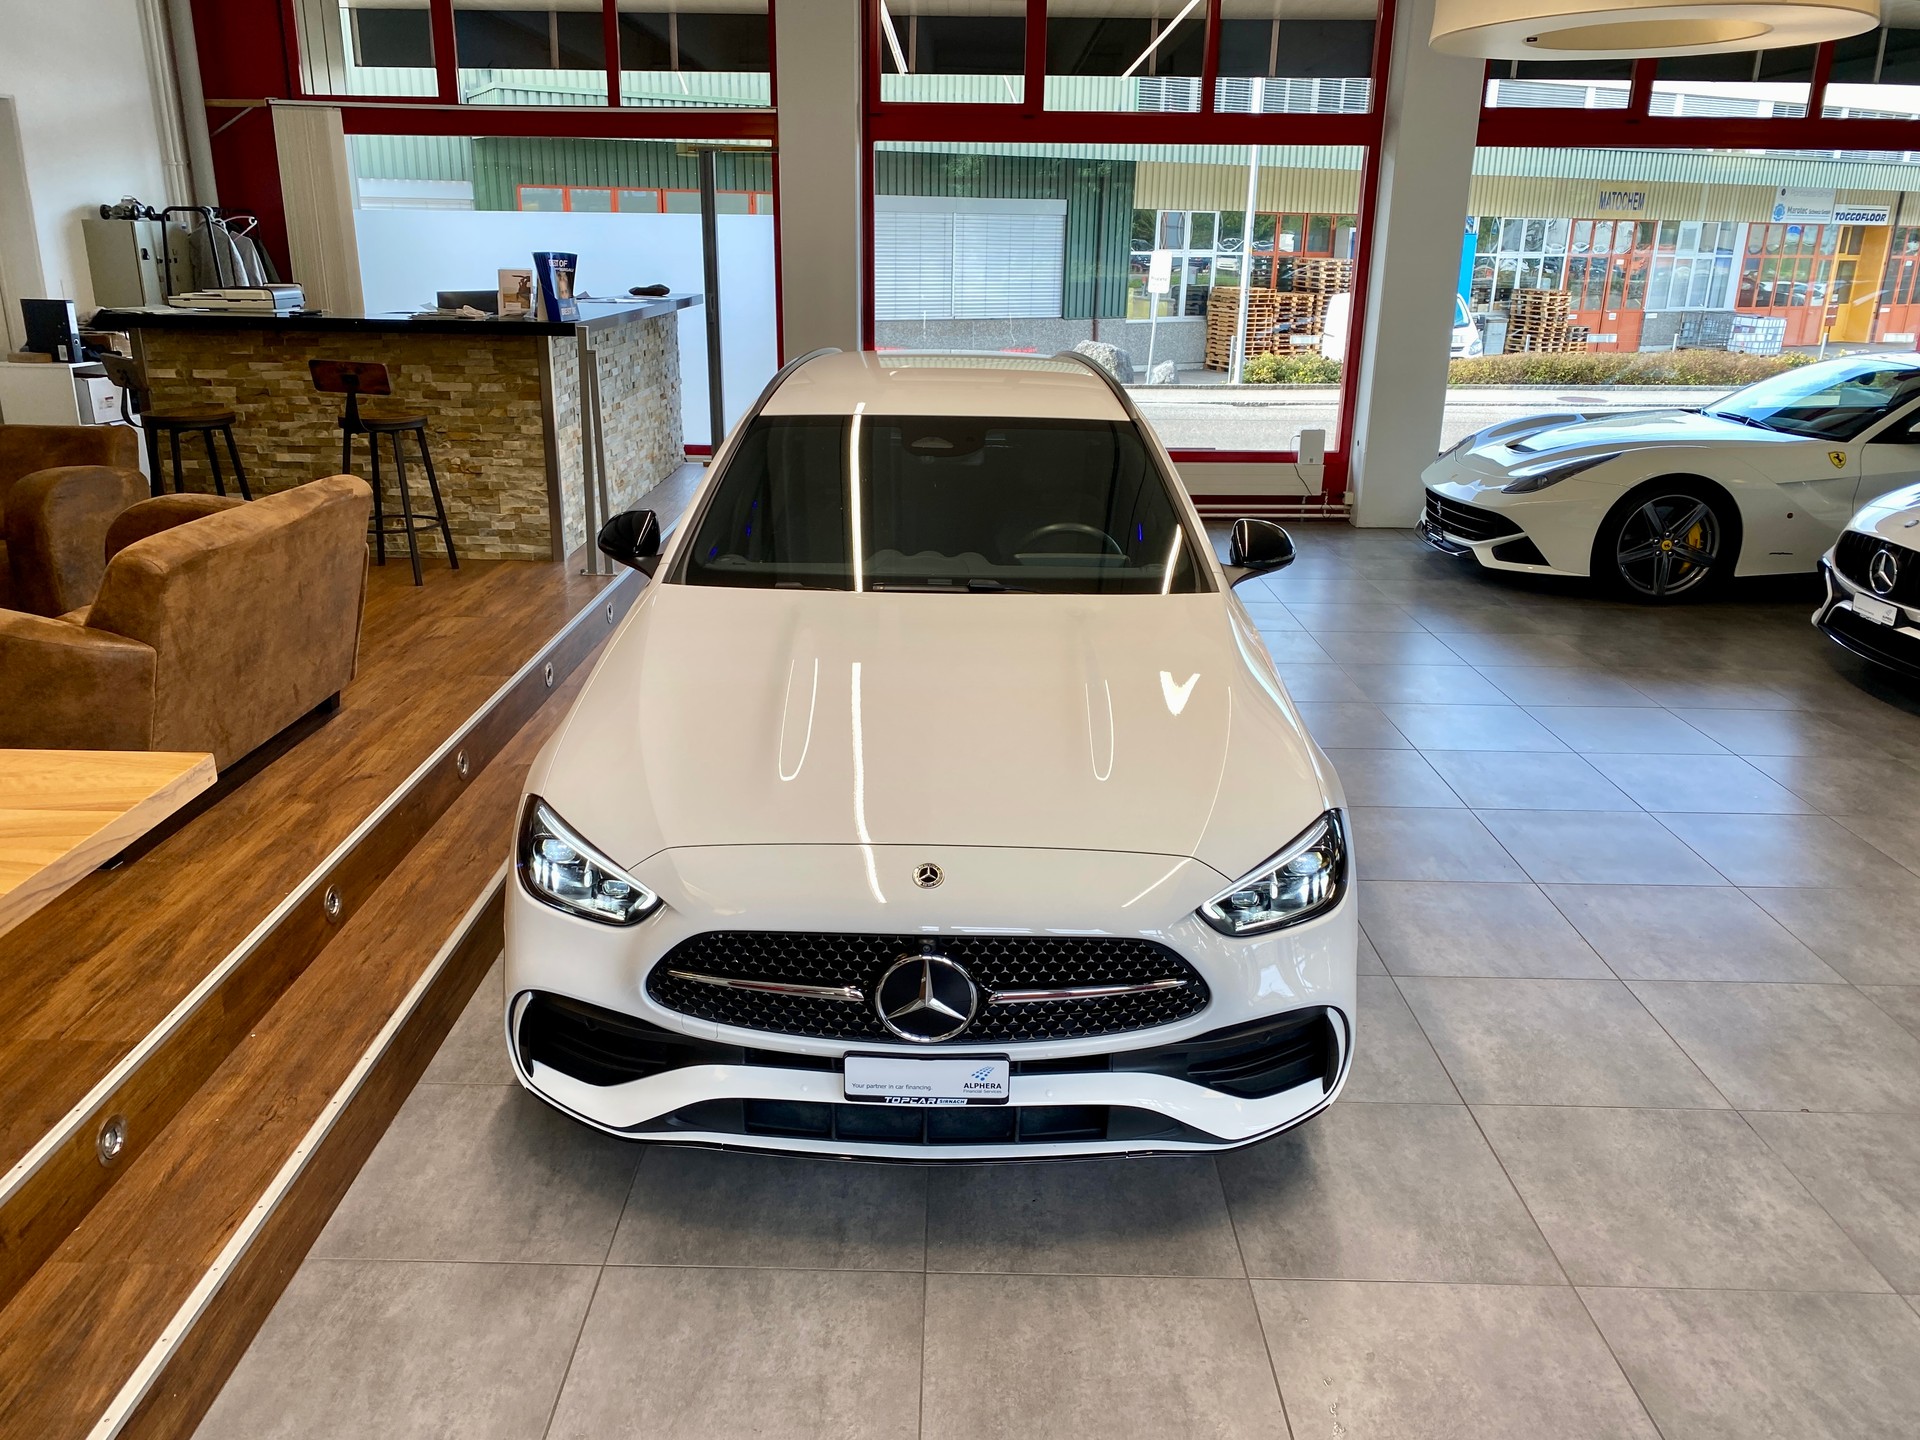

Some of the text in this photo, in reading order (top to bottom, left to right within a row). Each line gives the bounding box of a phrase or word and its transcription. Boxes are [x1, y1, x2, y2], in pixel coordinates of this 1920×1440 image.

[1599, 191, 1645, 210] MATOCHEM
[1835, 212, 1887, 222] TOGGOFLOOR
[884, 1096, 937, 1105] TOPCAR
